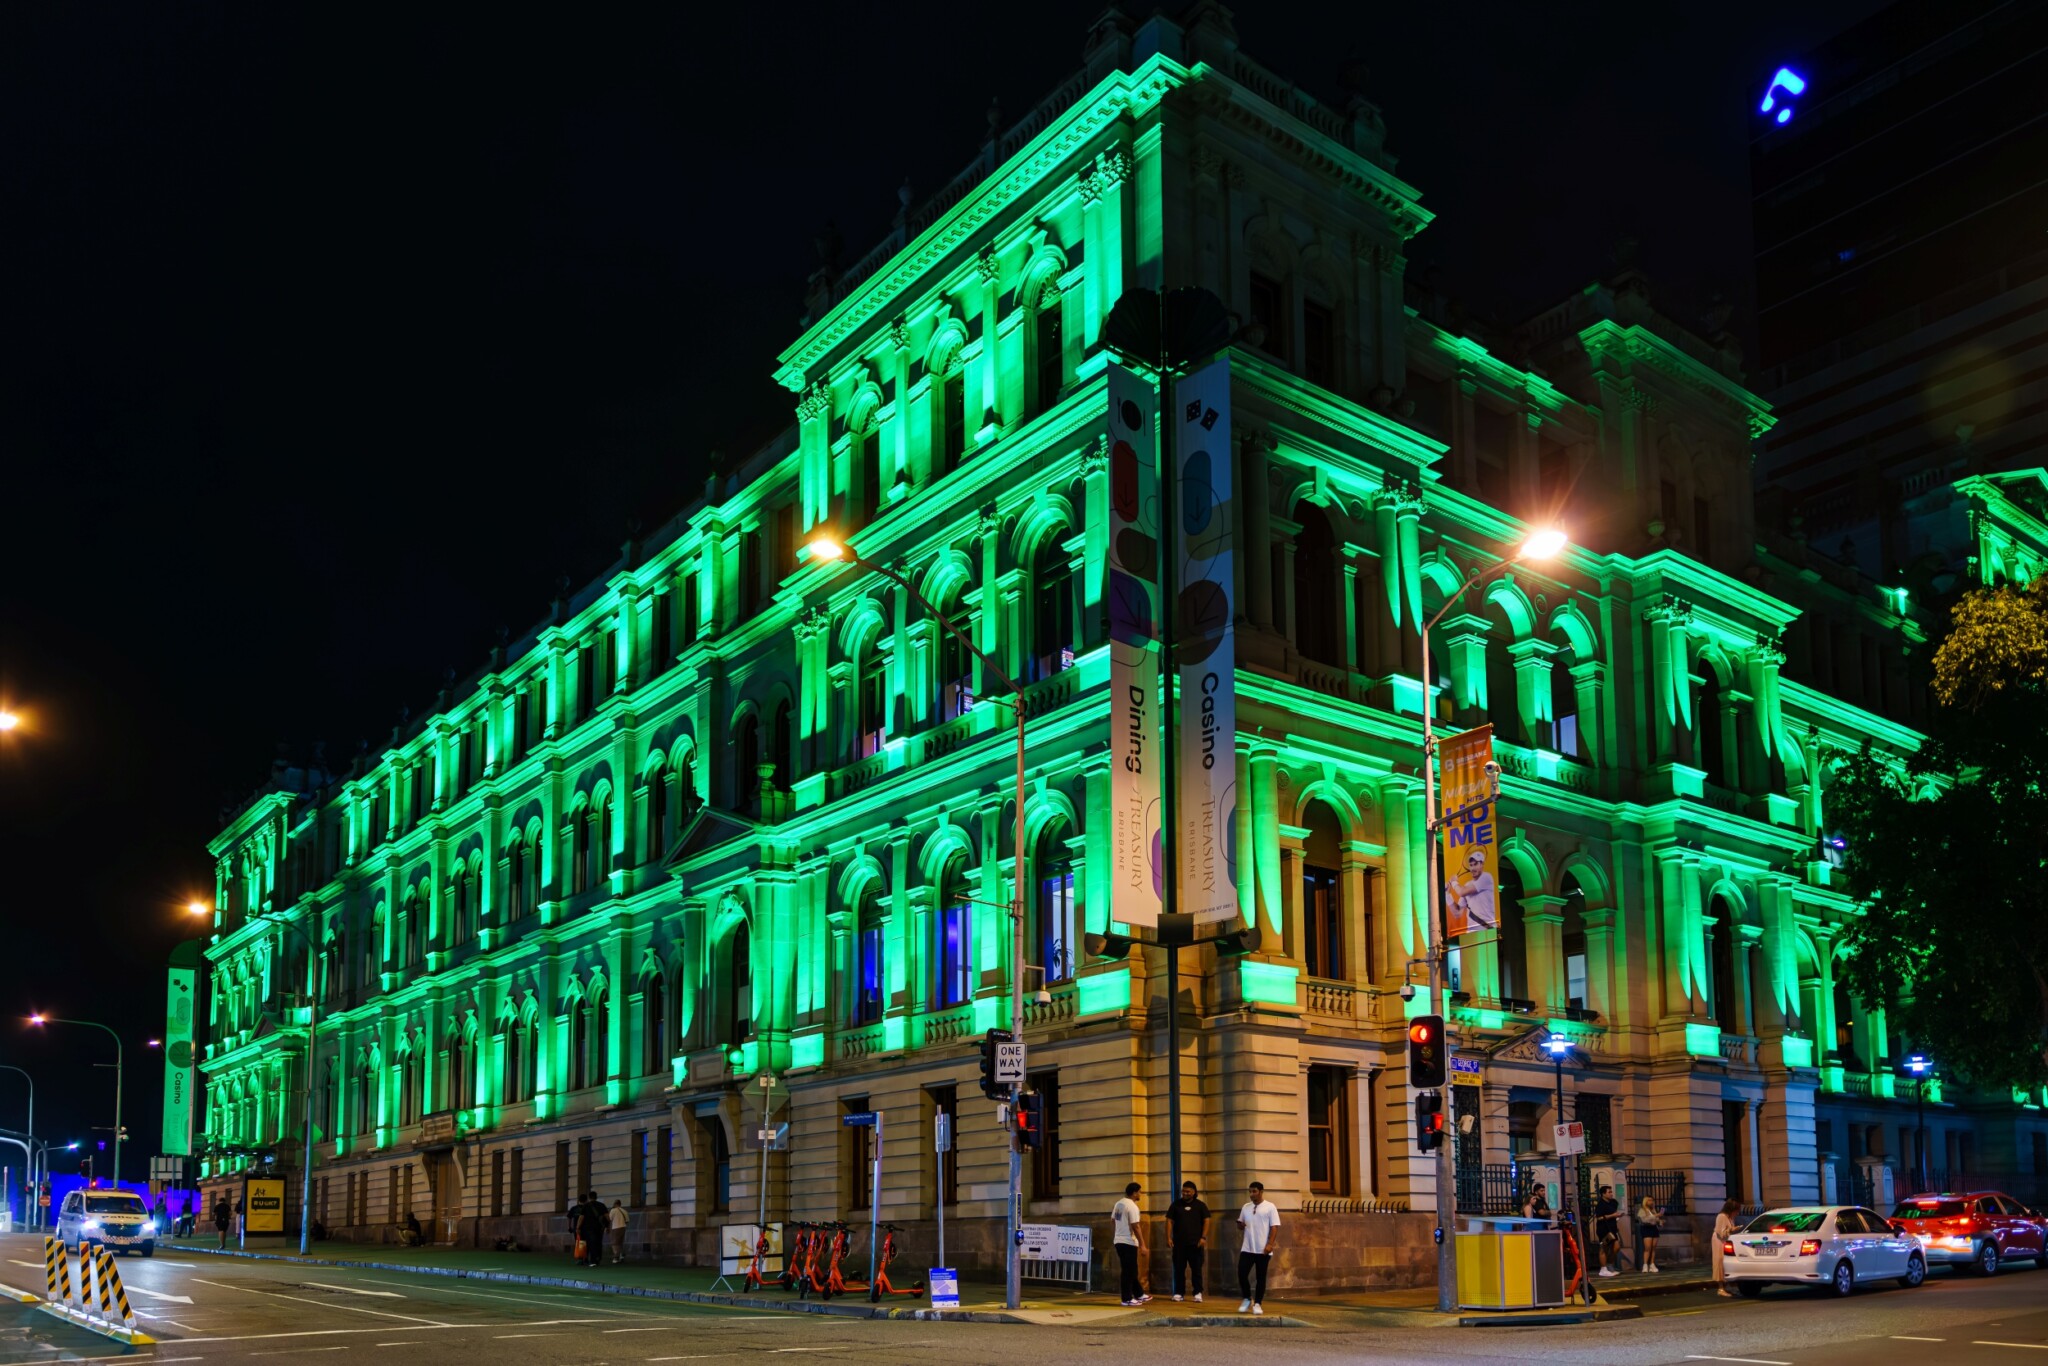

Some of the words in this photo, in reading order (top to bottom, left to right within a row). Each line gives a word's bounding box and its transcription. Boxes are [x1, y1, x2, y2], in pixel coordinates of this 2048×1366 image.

[1125, 684, 1146, 775] Dining
[1201, 672, 1220, 771] Casino
[1466, 793, 1485, 804] HITS
[1130, 787, 1143, 894] TREASURY
[1201, 781, 1216, 894] TREASURY
[1449, 823, 1493, 848] ME
[1188, 821, 1196, 880] BRISBANE
[999, 1058, 1022, 1068] WAY
[1000, 1046, 1021, 1056] ONE
[173, 1071, 184, 1105] Casino
[1057, 1232, 1088, 1243] FOOTPATH
[1060, 1245, 1084, 1255] CLOSED
